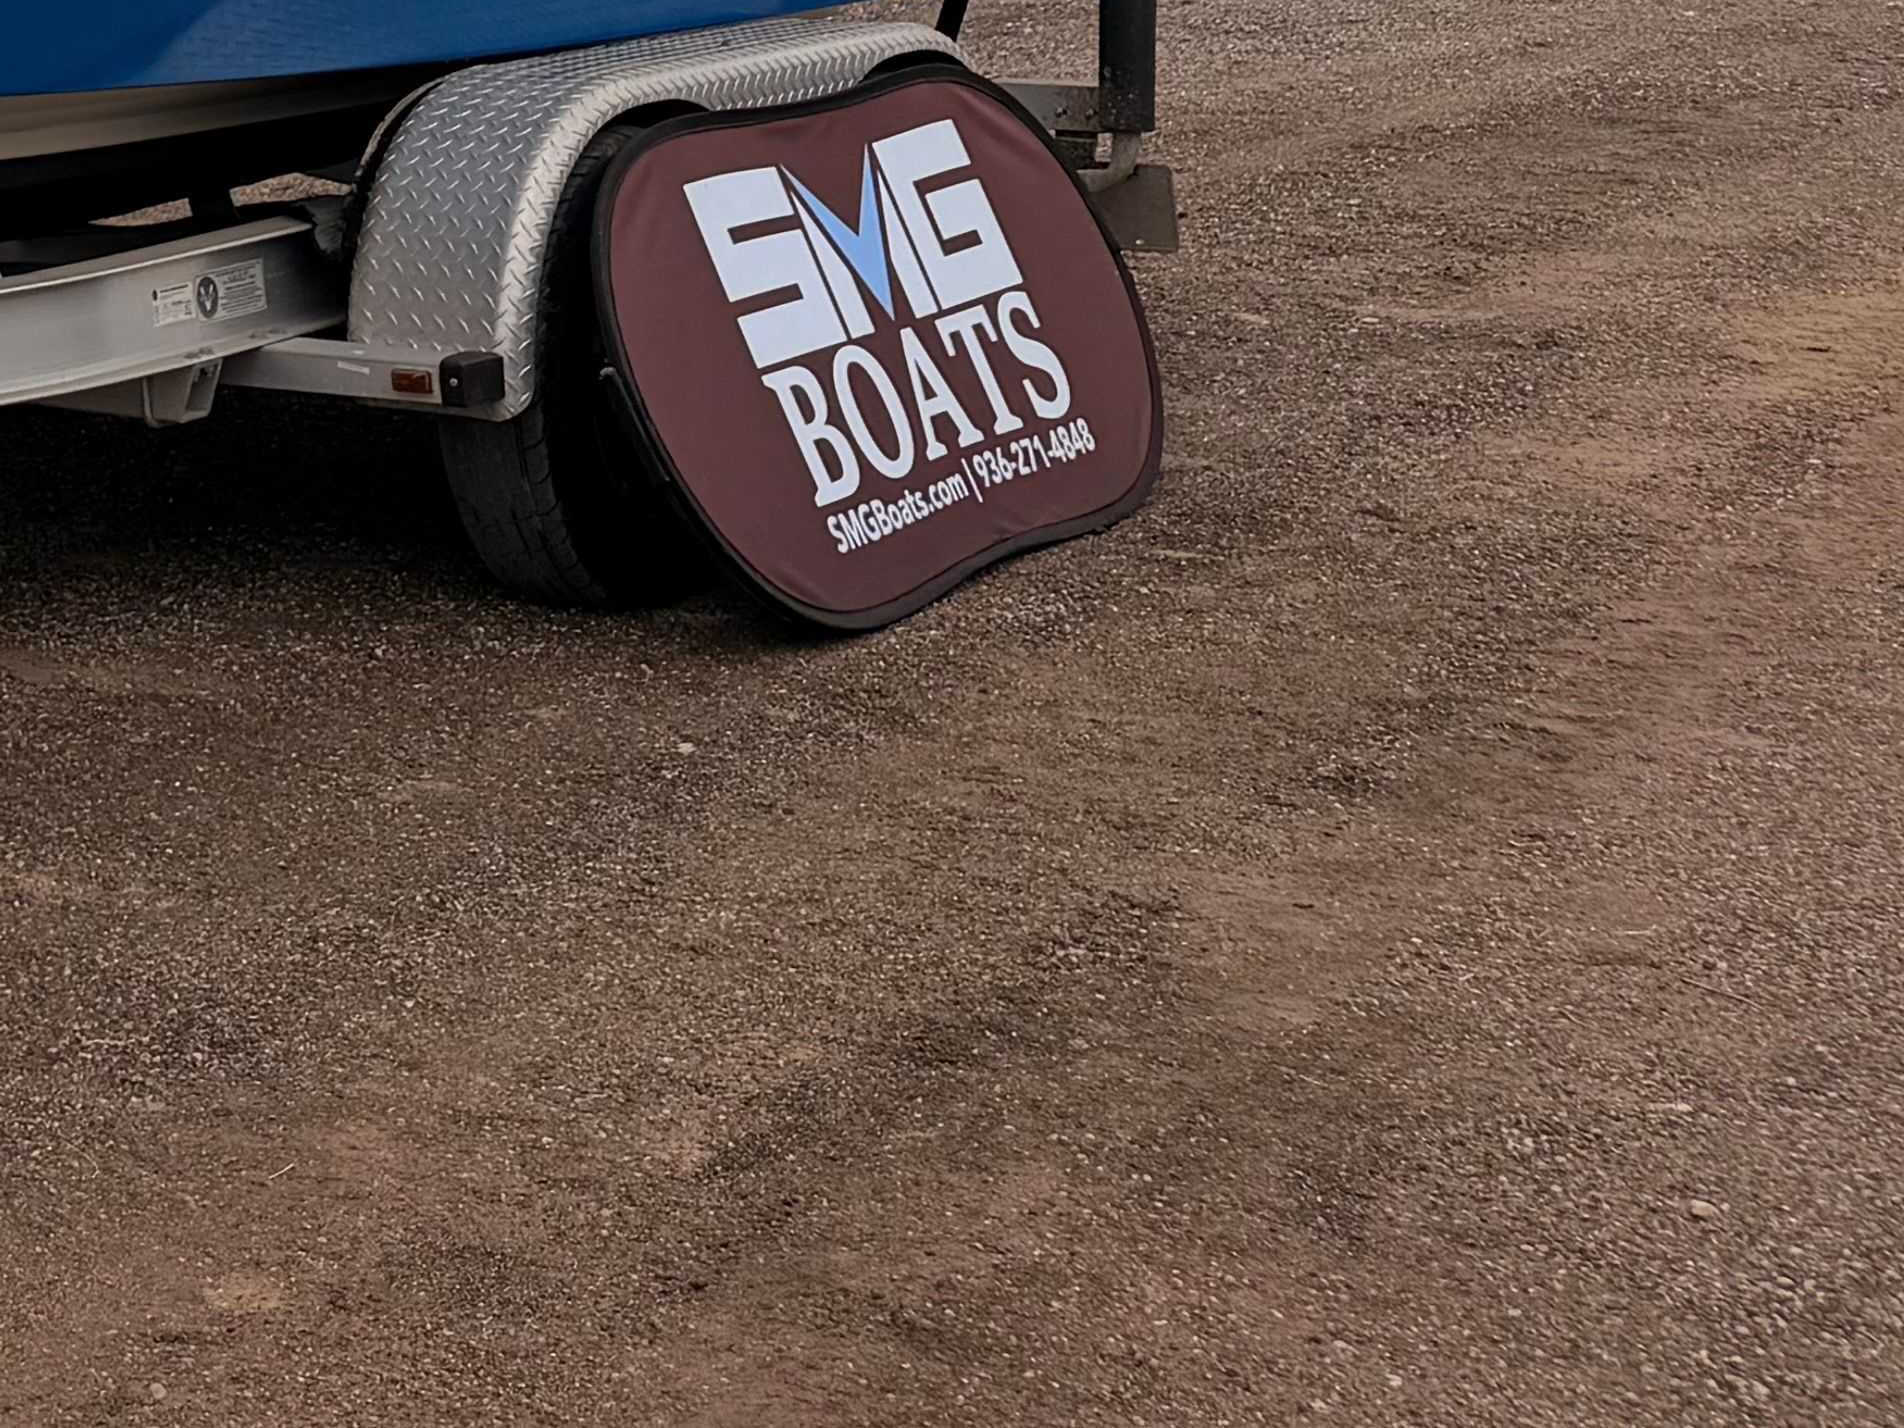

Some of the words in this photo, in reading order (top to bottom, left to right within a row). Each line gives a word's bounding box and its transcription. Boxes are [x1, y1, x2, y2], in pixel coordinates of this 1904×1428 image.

[683, 119, 1023, 370] SMG
[761, 291, 1071, 508] BOATS
[827, 473, 968, 554] SMGBoats.com
[972, 418, 1096, 488] 936-271-4848
